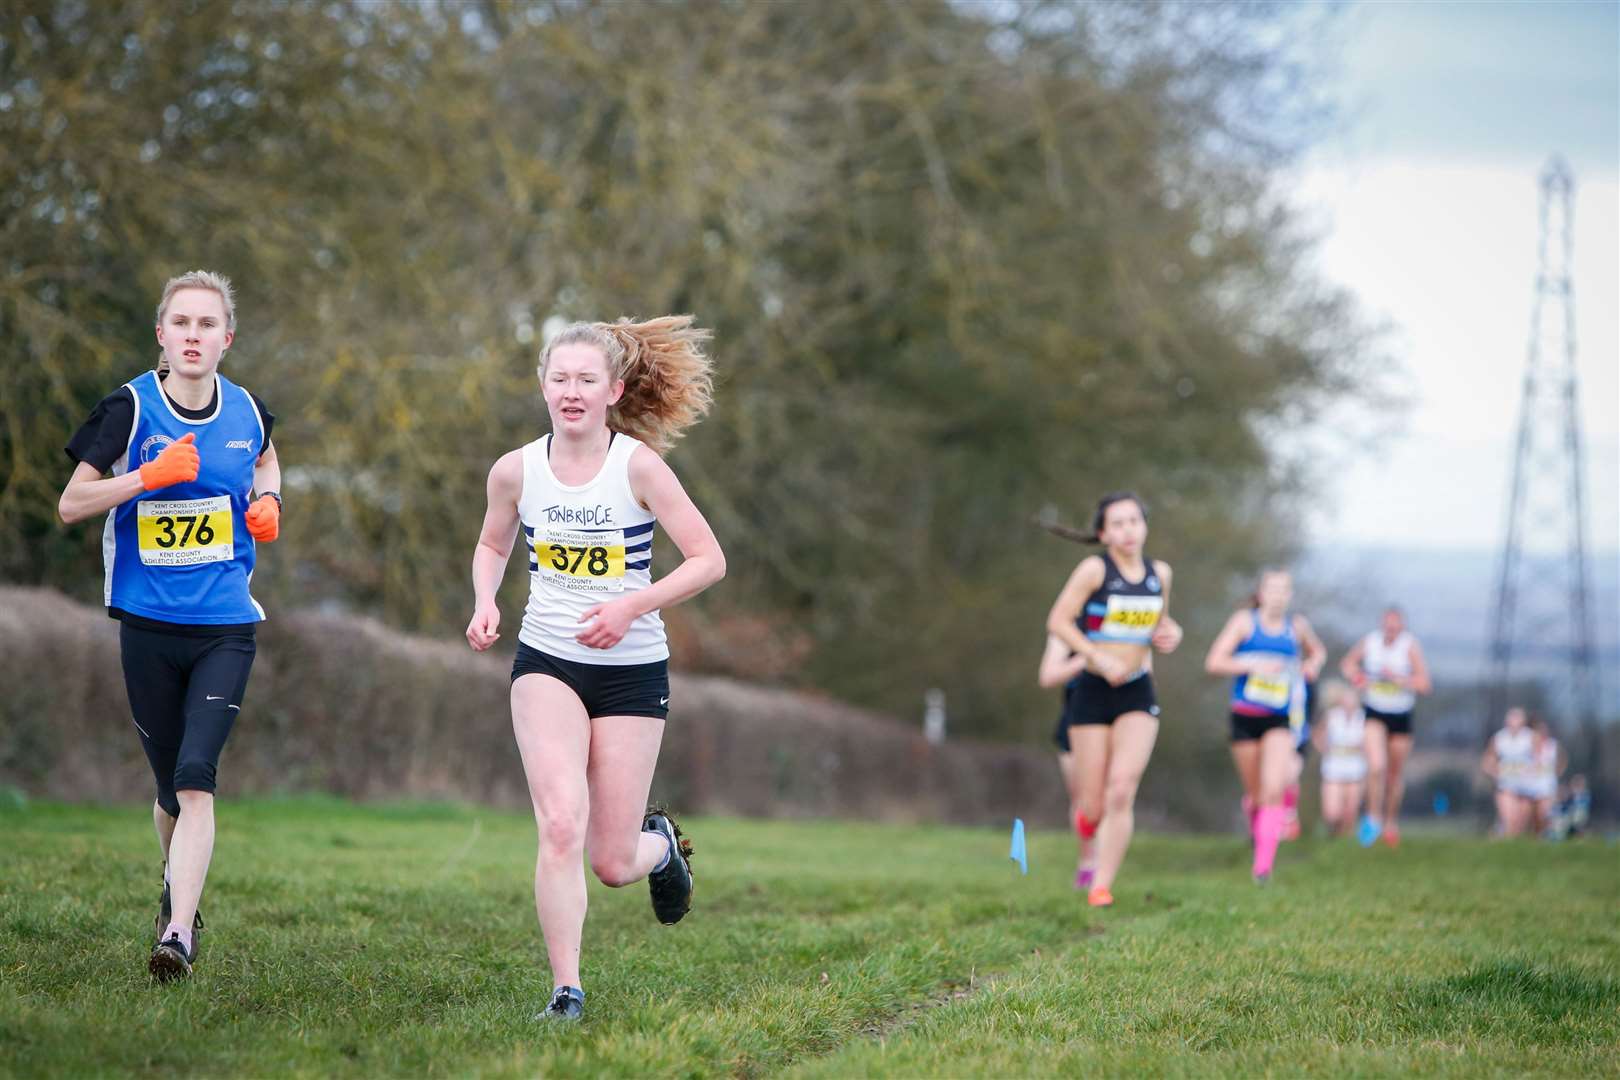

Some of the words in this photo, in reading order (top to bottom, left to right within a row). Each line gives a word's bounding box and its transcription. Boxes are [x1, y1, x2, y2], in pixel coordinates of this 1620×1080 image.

[542, 504, 613, 526] TONBRIDGE
[155, 514, 214, 548] 376
[546, 537, 589, 546] CHAMPIONSHIPS
[175, 556, 218, 564] ASSOCIATION
[549, 544, 609, 576] 378
[555, 573, 567, 581] KENT
[568, 577, 592, 585] COUNTY
